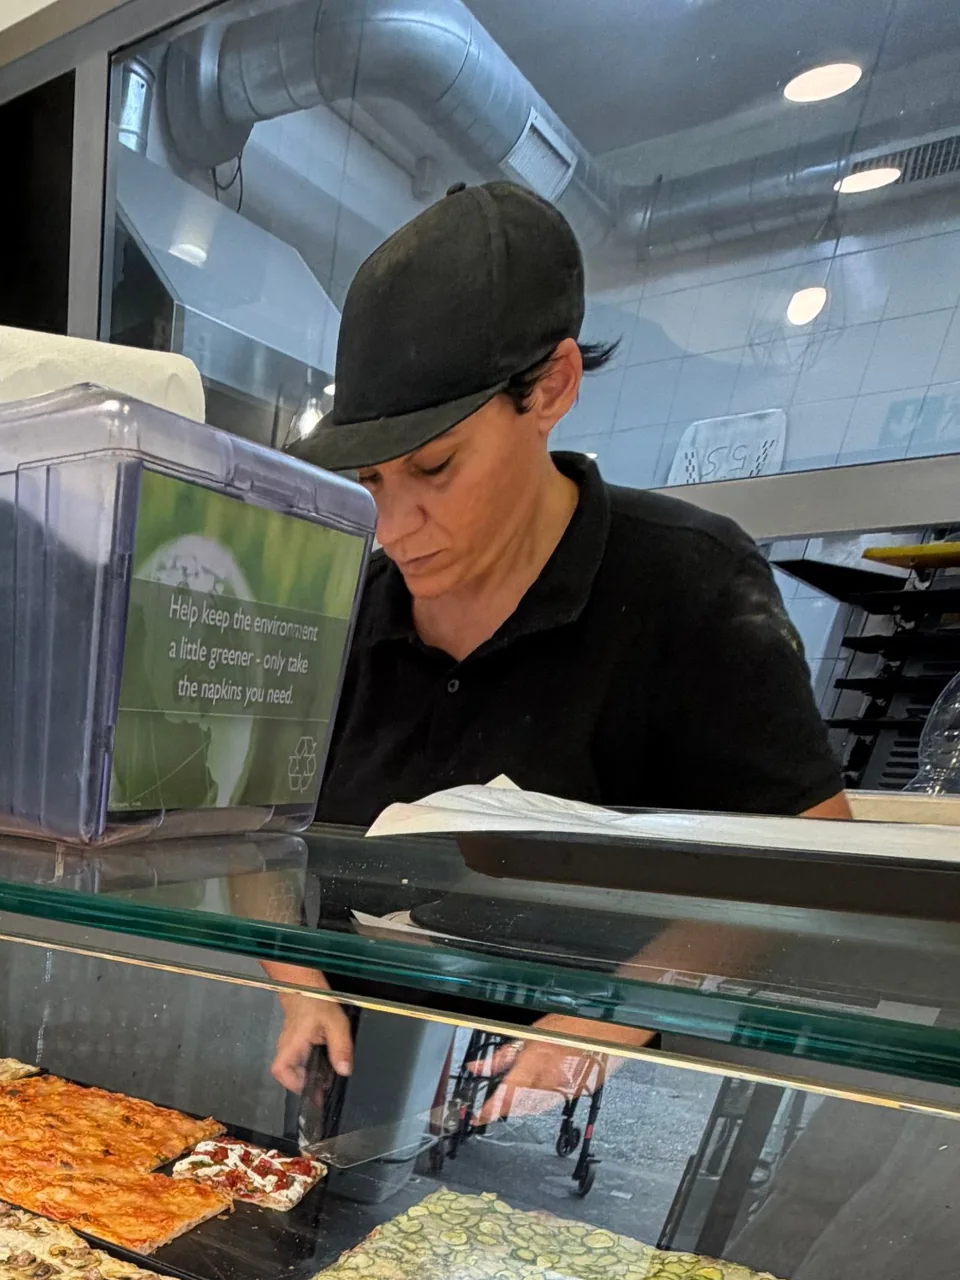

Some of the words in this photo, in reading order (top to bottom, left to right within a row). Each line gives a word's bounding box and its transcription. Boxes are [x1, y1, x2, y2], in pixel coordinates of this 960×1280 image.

[169, 593, 199, 628] Help
[201, 601, 230, 633] keep
[233, 607, 250, 630] the
[254, 616, 318, 641] environment
[169, 642, 176, 657] a
[180, 636, 206, 661] little
[209, 648, 254, 669] greener
[263, 650, 286, 676] only
[288, 653, 308, 673] take
[178, 675, 197, 696] the
[201, 678, 241, 705] napkins
[244, 687, 263, 707] you
[268, 686, 293, 704] need.
